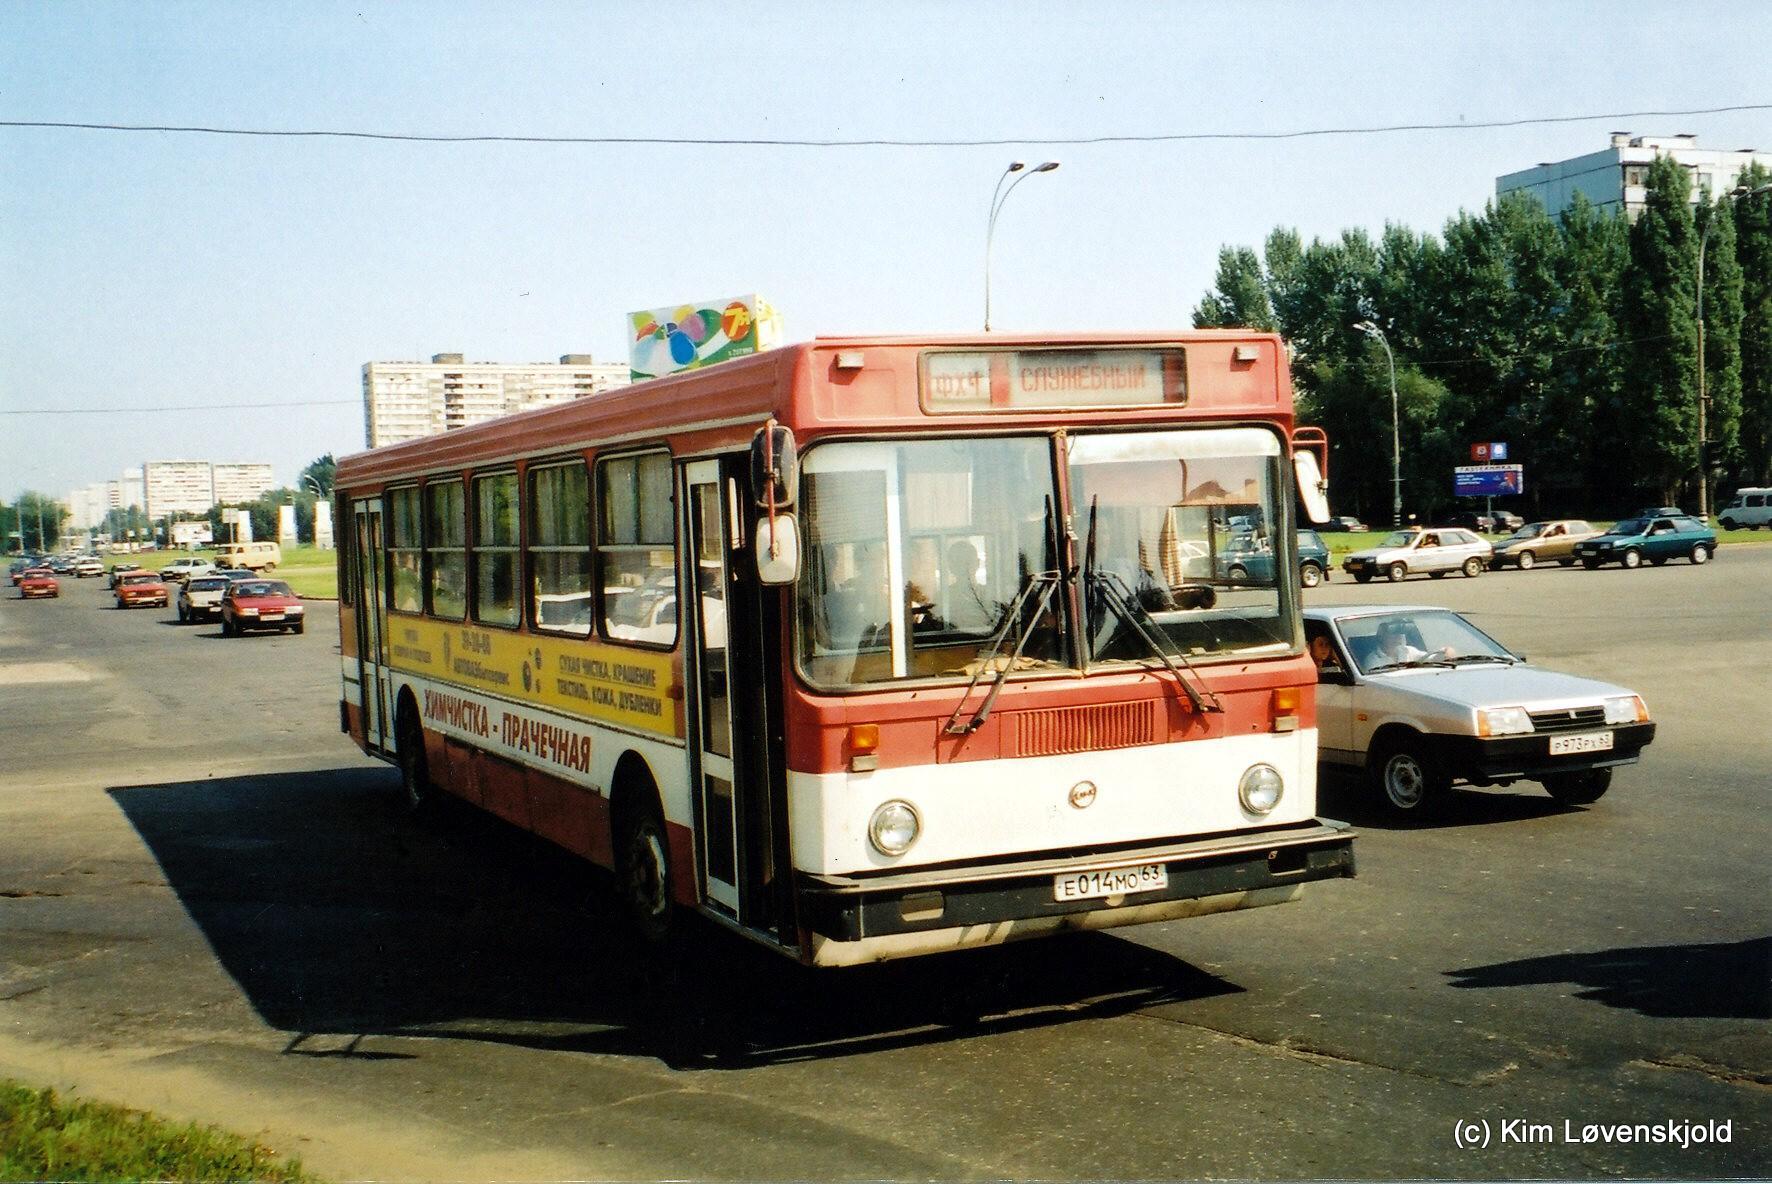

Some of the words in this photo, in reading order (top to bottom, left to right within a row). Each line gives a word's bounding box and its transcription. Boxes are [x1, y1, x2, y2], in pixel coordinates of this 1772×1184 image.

[424, 689, 489, 738] ХИМЧИСТКА
[502, 712, 591, 774] ПРАЧЕЧНАЯ
[1142, 865, 1160, 881] 63
